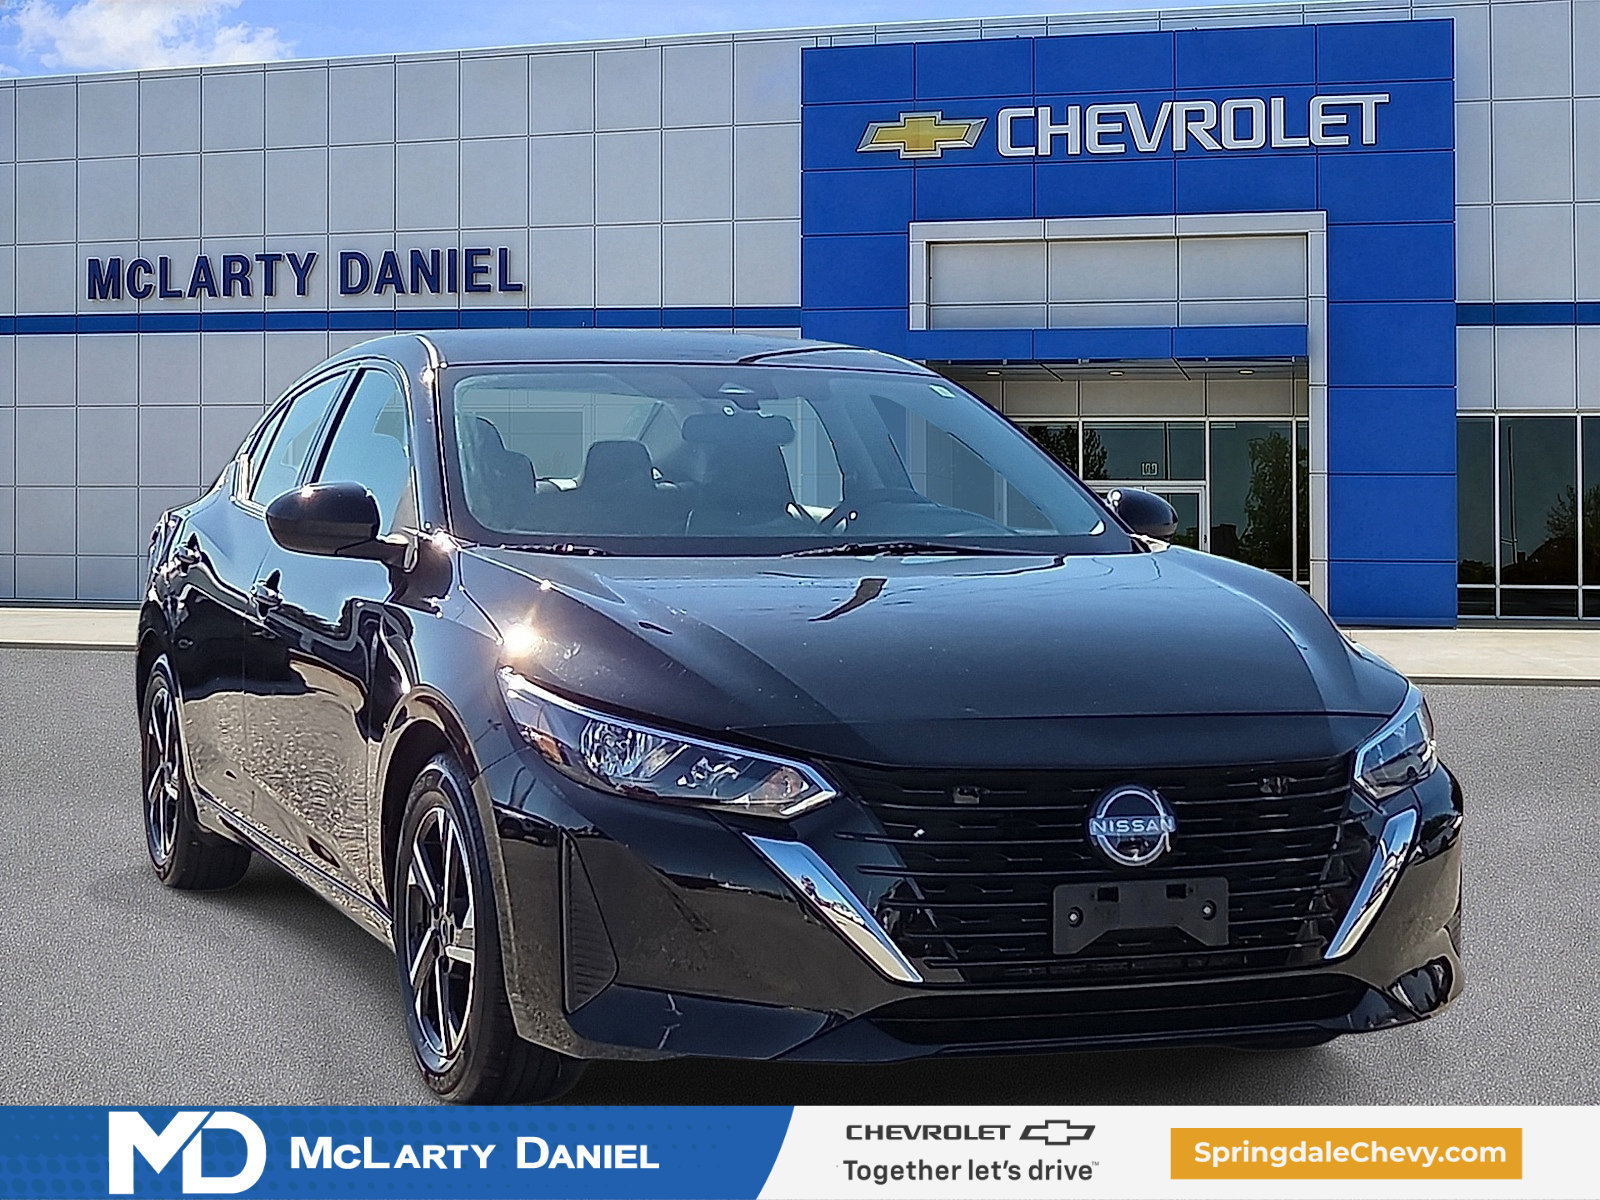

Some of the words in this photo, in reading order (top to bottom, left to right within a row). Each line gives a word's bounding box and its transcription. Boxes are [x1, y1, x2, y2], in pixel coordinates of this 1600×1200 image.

[997, 93, 1391, 156] CHEVROLET
[339, 246, 526, 296] DANIEL
[1091, 818, 1174, 833] NISSAN
